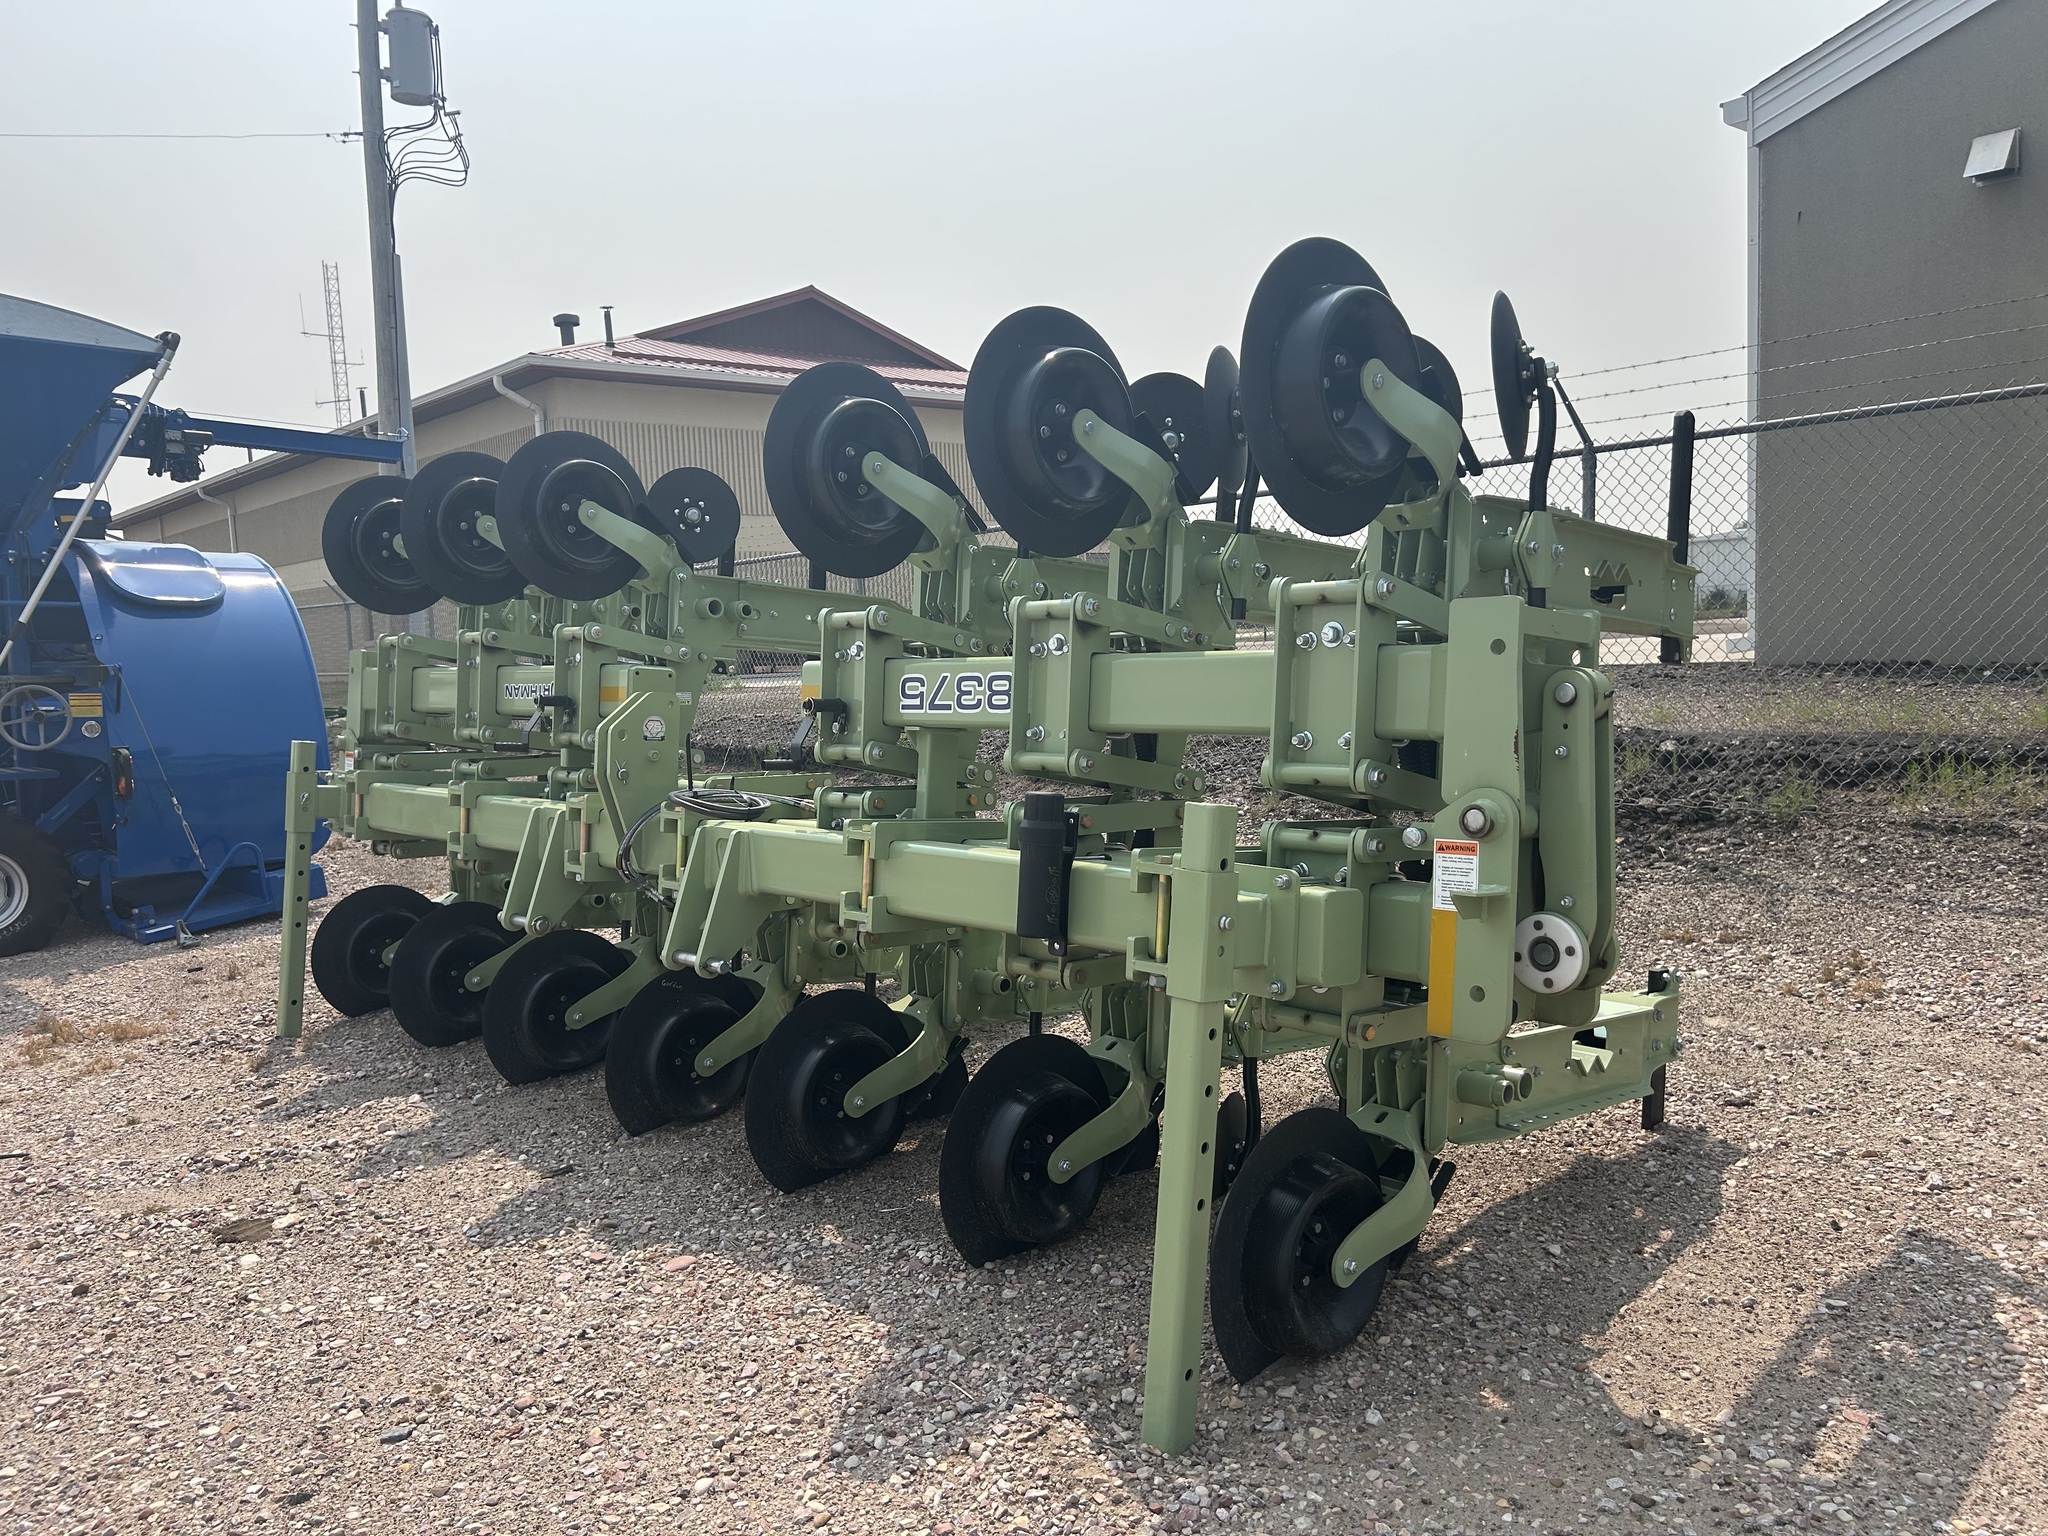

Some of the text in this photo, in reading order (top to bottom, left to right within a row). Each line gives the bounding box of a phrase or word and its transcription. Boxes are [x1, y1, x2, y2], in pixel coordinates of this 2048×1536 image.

[504, 681, 555, 699] RTHMAN
[899, 671, 1013, 713] 8375
[1444, 844, 1476, 853] WARNING
